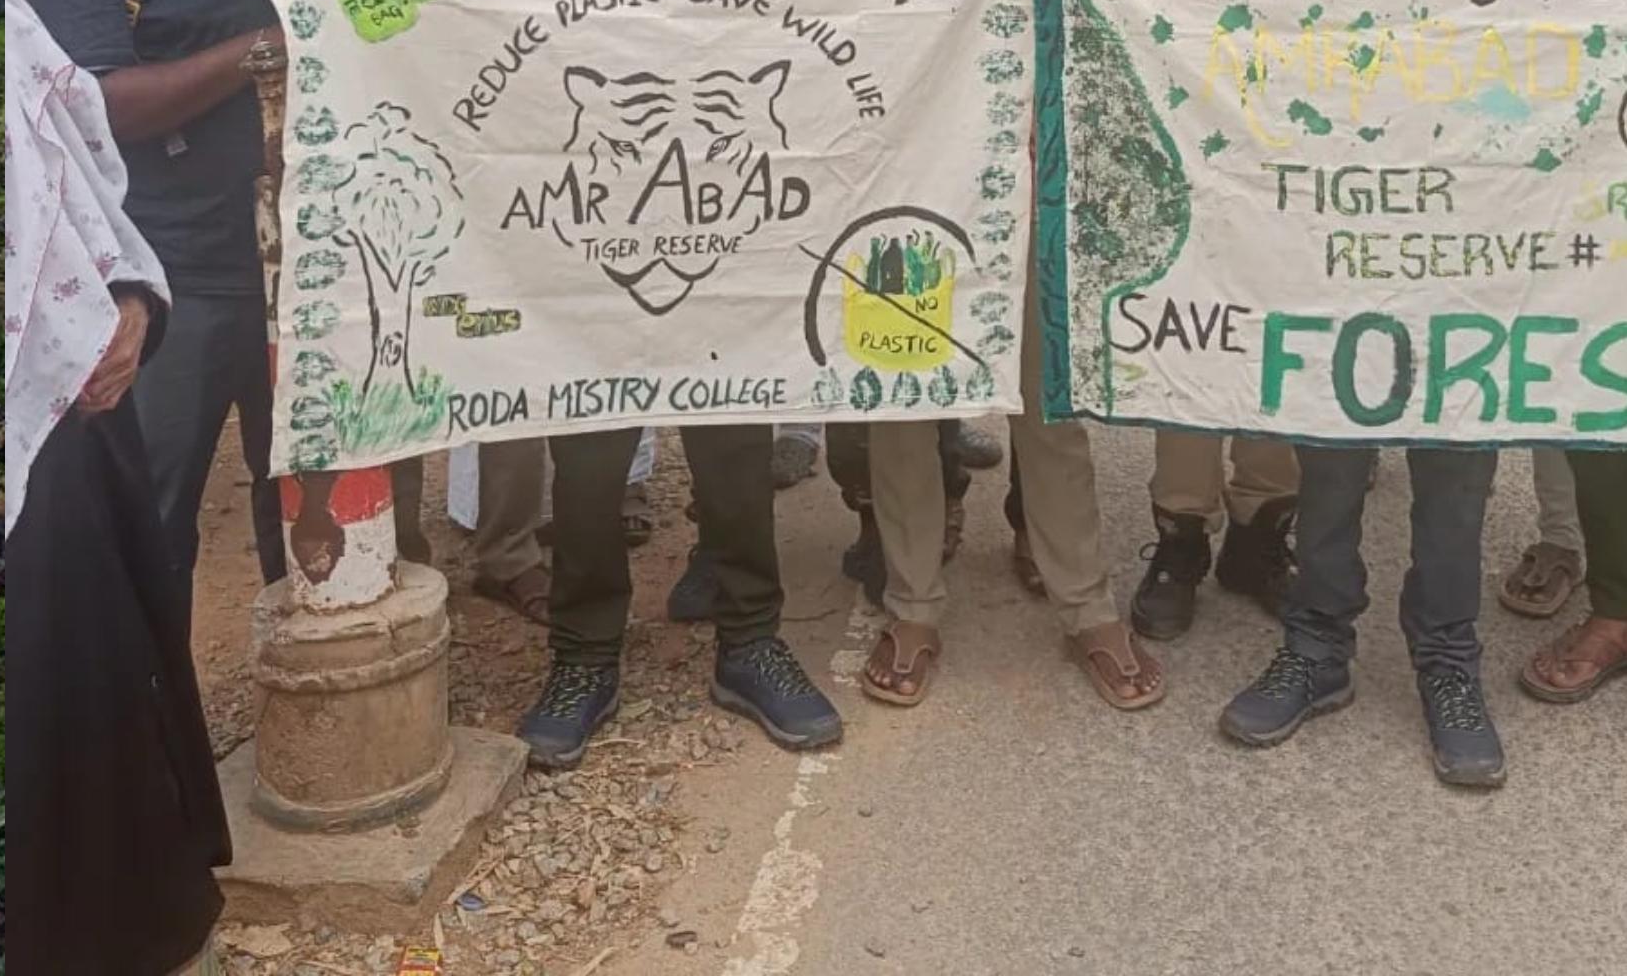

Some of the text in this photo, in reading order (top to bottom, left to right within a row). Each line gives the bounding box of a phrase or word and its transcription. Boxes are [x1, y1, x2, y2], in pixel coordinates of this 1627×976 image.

[452, 15, 551, 132] REDUCE
[781, 5, 857, 67] WILD
[846, 72, 886, 121] LIFE
[1260, 161, 1456, 216] TIGER
[580, 234, 744, 261] TIGER RESERVE
[1325, 228, 1560, 280] RESERVE
[913, 297, 939, 314] NO
[1108, 292, 1252, 355] SAVE
[859, 332, 938, 355] PLASTIC
[447, 377, 787, 437] RODA MISTRY COLLEGE
